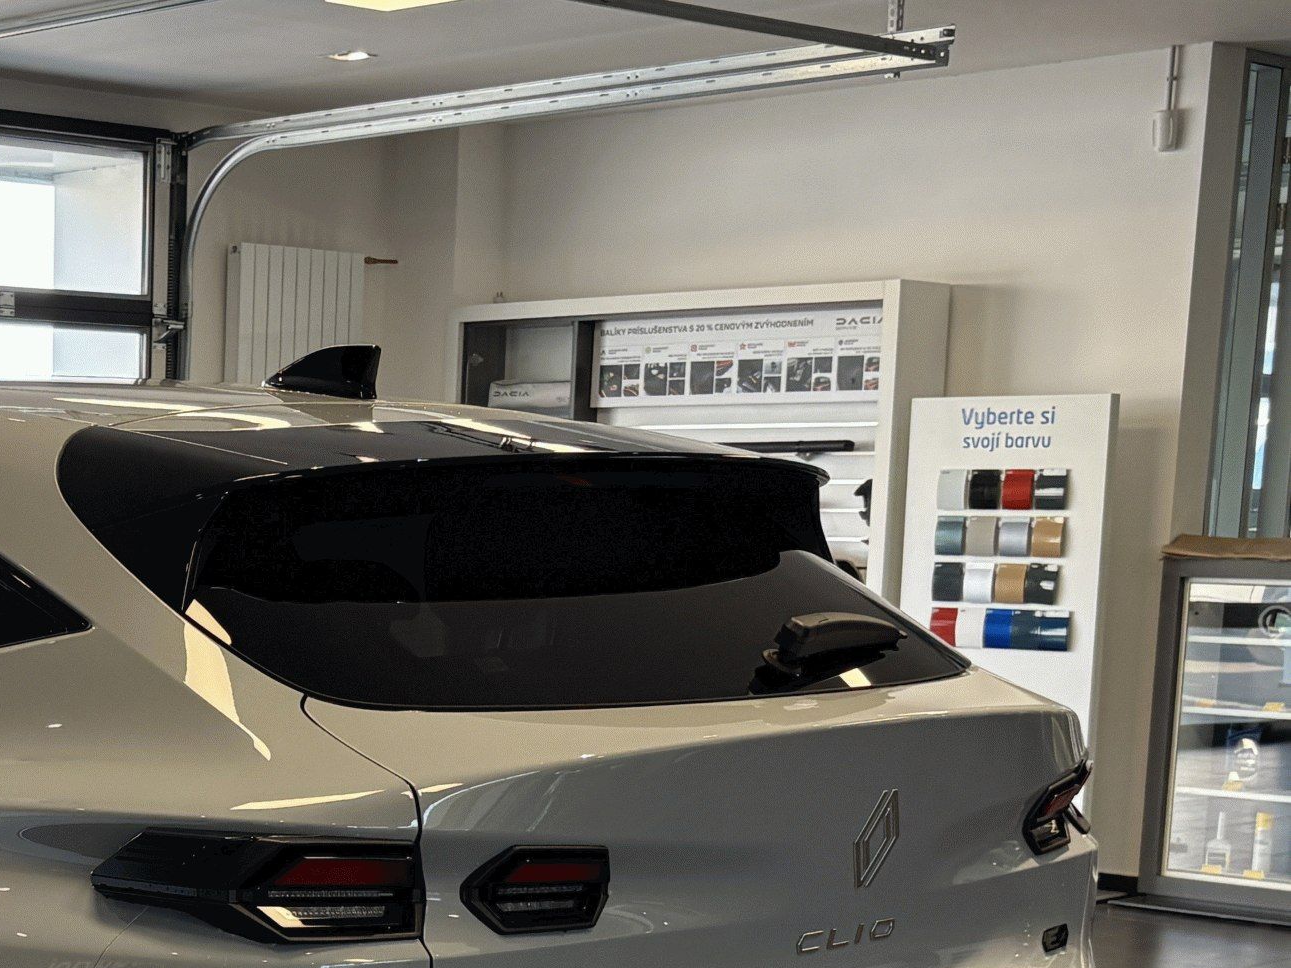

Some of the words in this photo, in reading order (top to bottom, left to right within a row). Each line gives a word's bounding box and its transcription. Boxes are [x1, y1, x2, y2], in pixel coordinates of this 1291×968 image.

[695, 324, 705, 332] 20
[714, 320, 753, 331] CENOVÝM
[961, 407, 1035, 429] Vyberte
[1040, 406, 1056, 425] si
[962, 432, 1001, 452] svojí
[1005, 432, 1051, 449] barvu
[796, 917, 896, 954] CLIO
